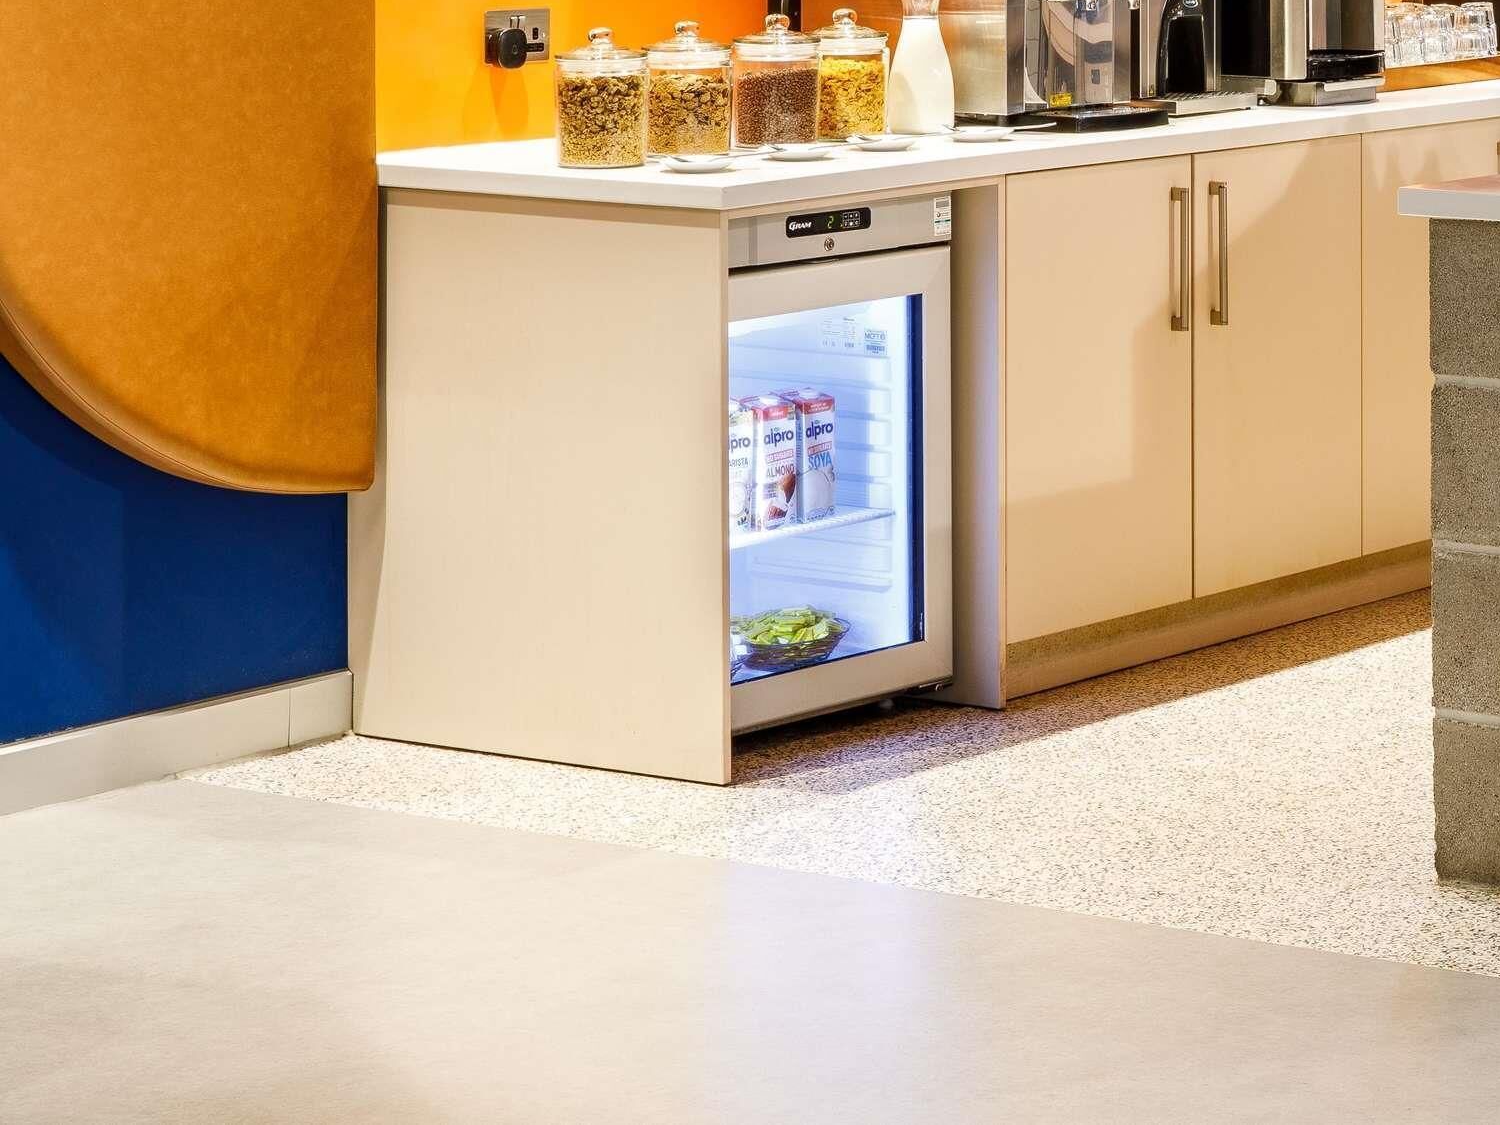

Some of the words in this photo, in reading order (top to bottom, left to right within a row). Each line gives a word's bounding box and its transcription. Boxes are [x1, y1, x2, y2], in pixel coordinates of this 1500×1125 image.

[827, 215, 834, 229] 2
[763, 428, 794, 447] alpro
[806, 420, 834, 440] alpro
[730, 436, 751, 453] pro
[808, 451, 833, 469] SOYA
[767, 463, 795, 478] ALMOND
